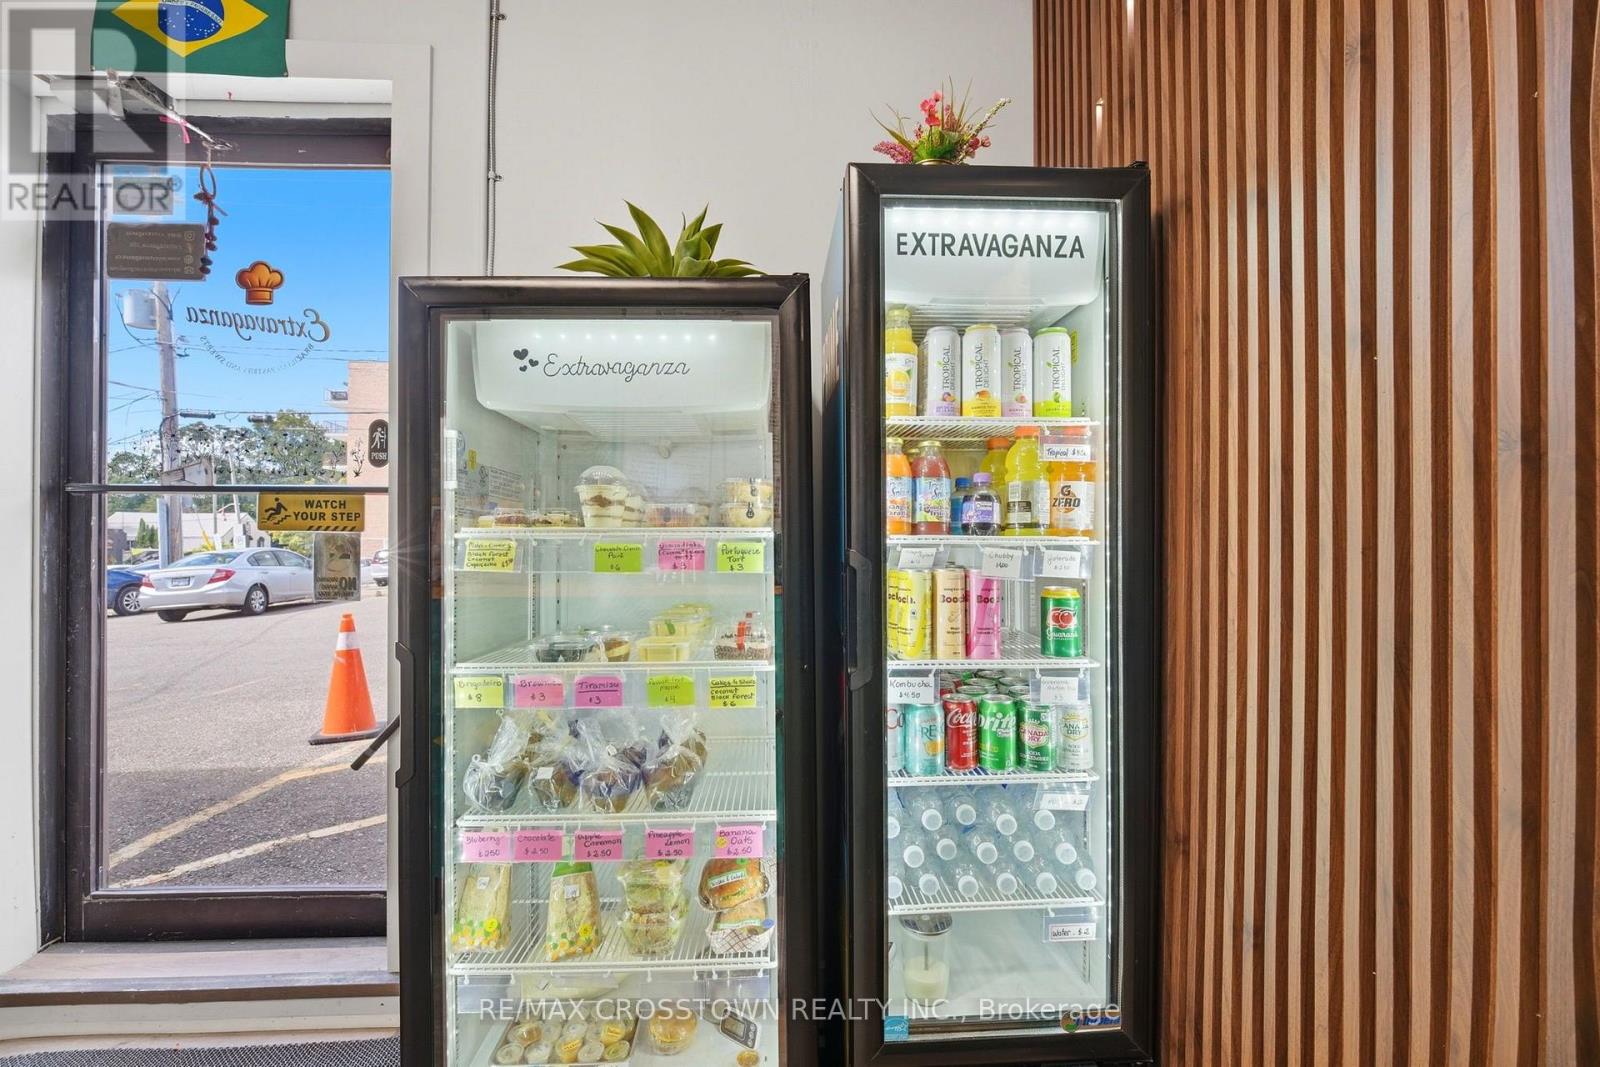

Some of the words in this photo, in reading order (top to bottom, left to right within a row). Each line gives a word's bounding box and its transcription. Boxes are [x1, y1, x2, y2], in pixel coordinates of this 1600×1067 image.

[896, 232, 1085, 259] EXTRAVAGANZA
[543, 353, 691, 383] Extravaganza
[943, 345, 951, 390] TROPICAL
[975, 343, 984, 389] TROPICAL
[1013, 346, 1022, 391] TROPICAL
[1052, 346, 1061, 390] TROPICAL
[371, 452, 387, 461] PUSH
[1052, 497, 1081, 508] ZERO
[1061, 485, 1071, 496] G
[293, 512, 326, 521] YOUR
[330, 512, 361, 521] STEP
[304, 500, 347, 509] WATCH
